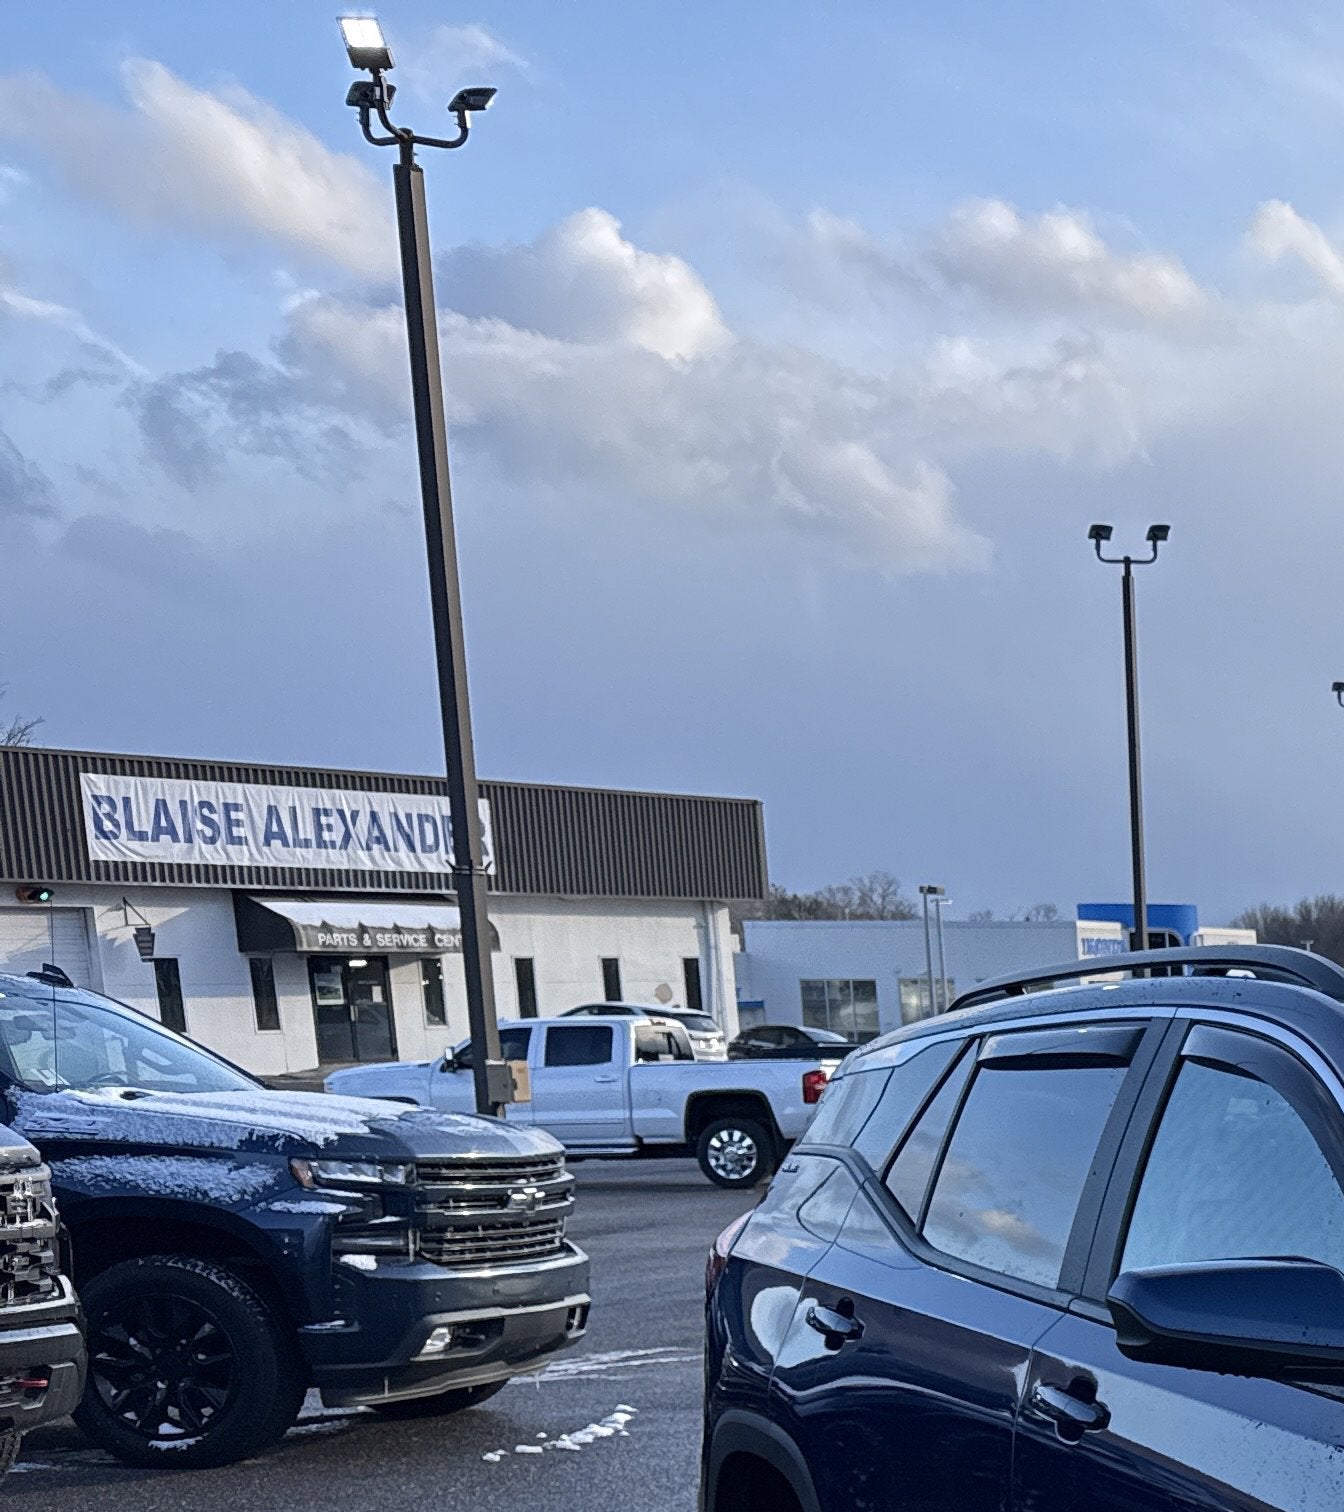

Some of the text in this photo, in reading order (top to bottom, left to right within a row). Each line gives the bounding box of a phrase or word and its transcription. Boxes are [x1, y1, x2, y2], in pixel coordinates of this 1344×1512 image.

[91, 794, 490, 858] BLAISE ALEXANDE
[318, 933, 463, 948] PARTS & SERVICE CENT
